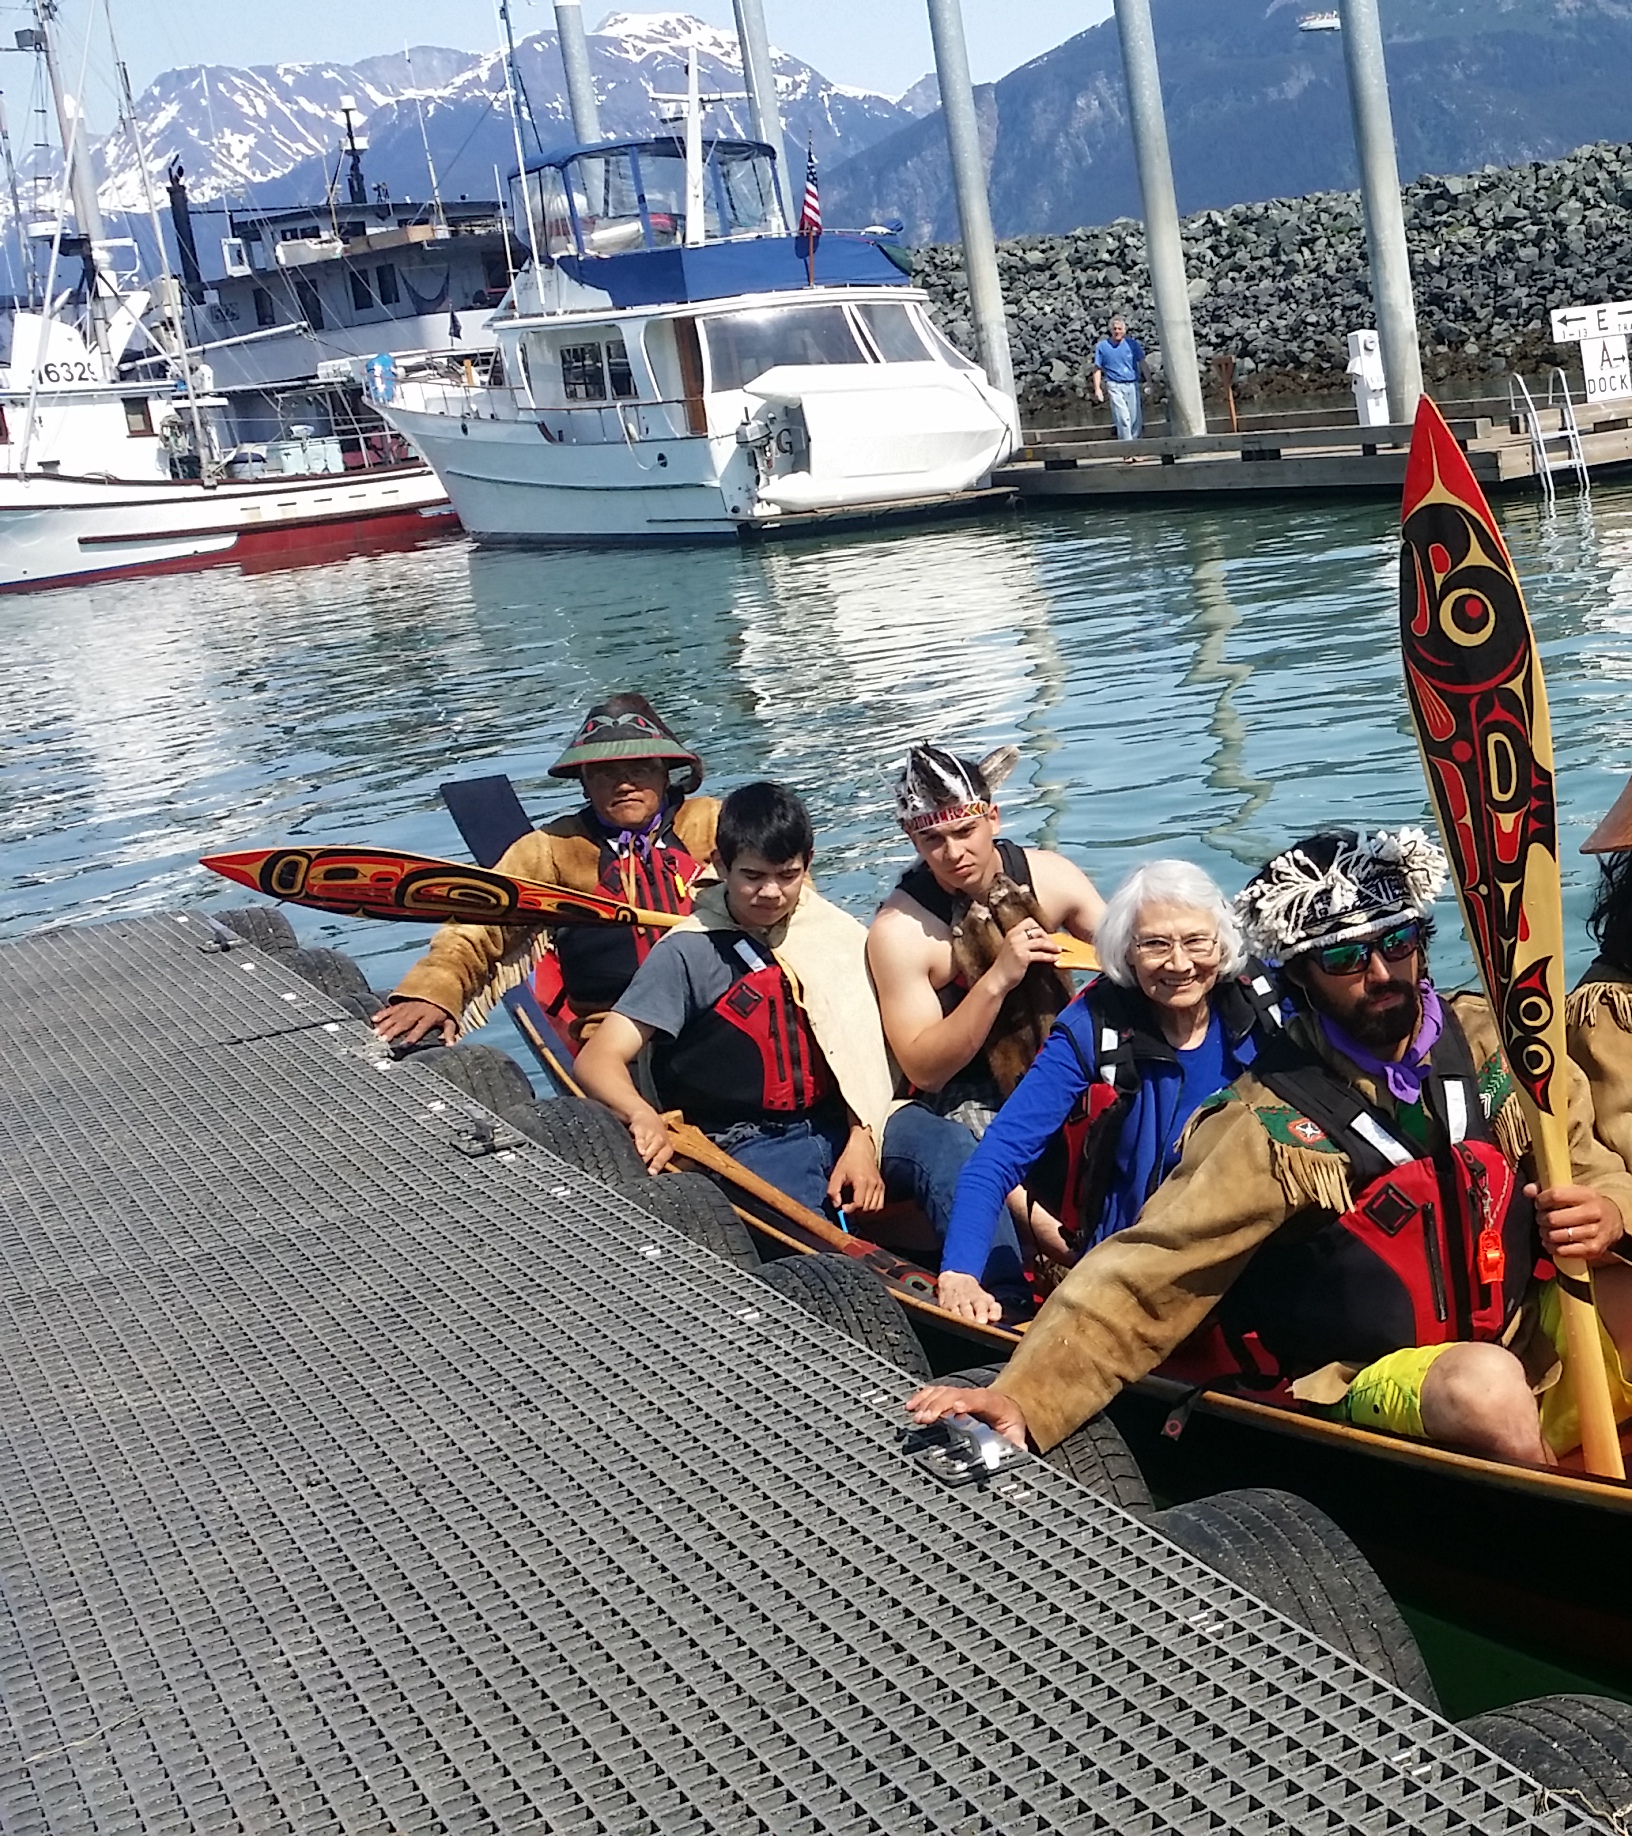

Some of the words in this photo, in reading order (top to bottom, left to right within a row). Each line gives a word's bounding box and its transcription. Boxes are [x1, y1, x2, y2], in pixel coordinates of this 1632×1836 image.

[1597, 309, 1609, 331] E
[1562, 328, 1588, 339] 1-13
[1601, 340, 1613, 369] A
[1587, 374, 1629, 395] DOCK
